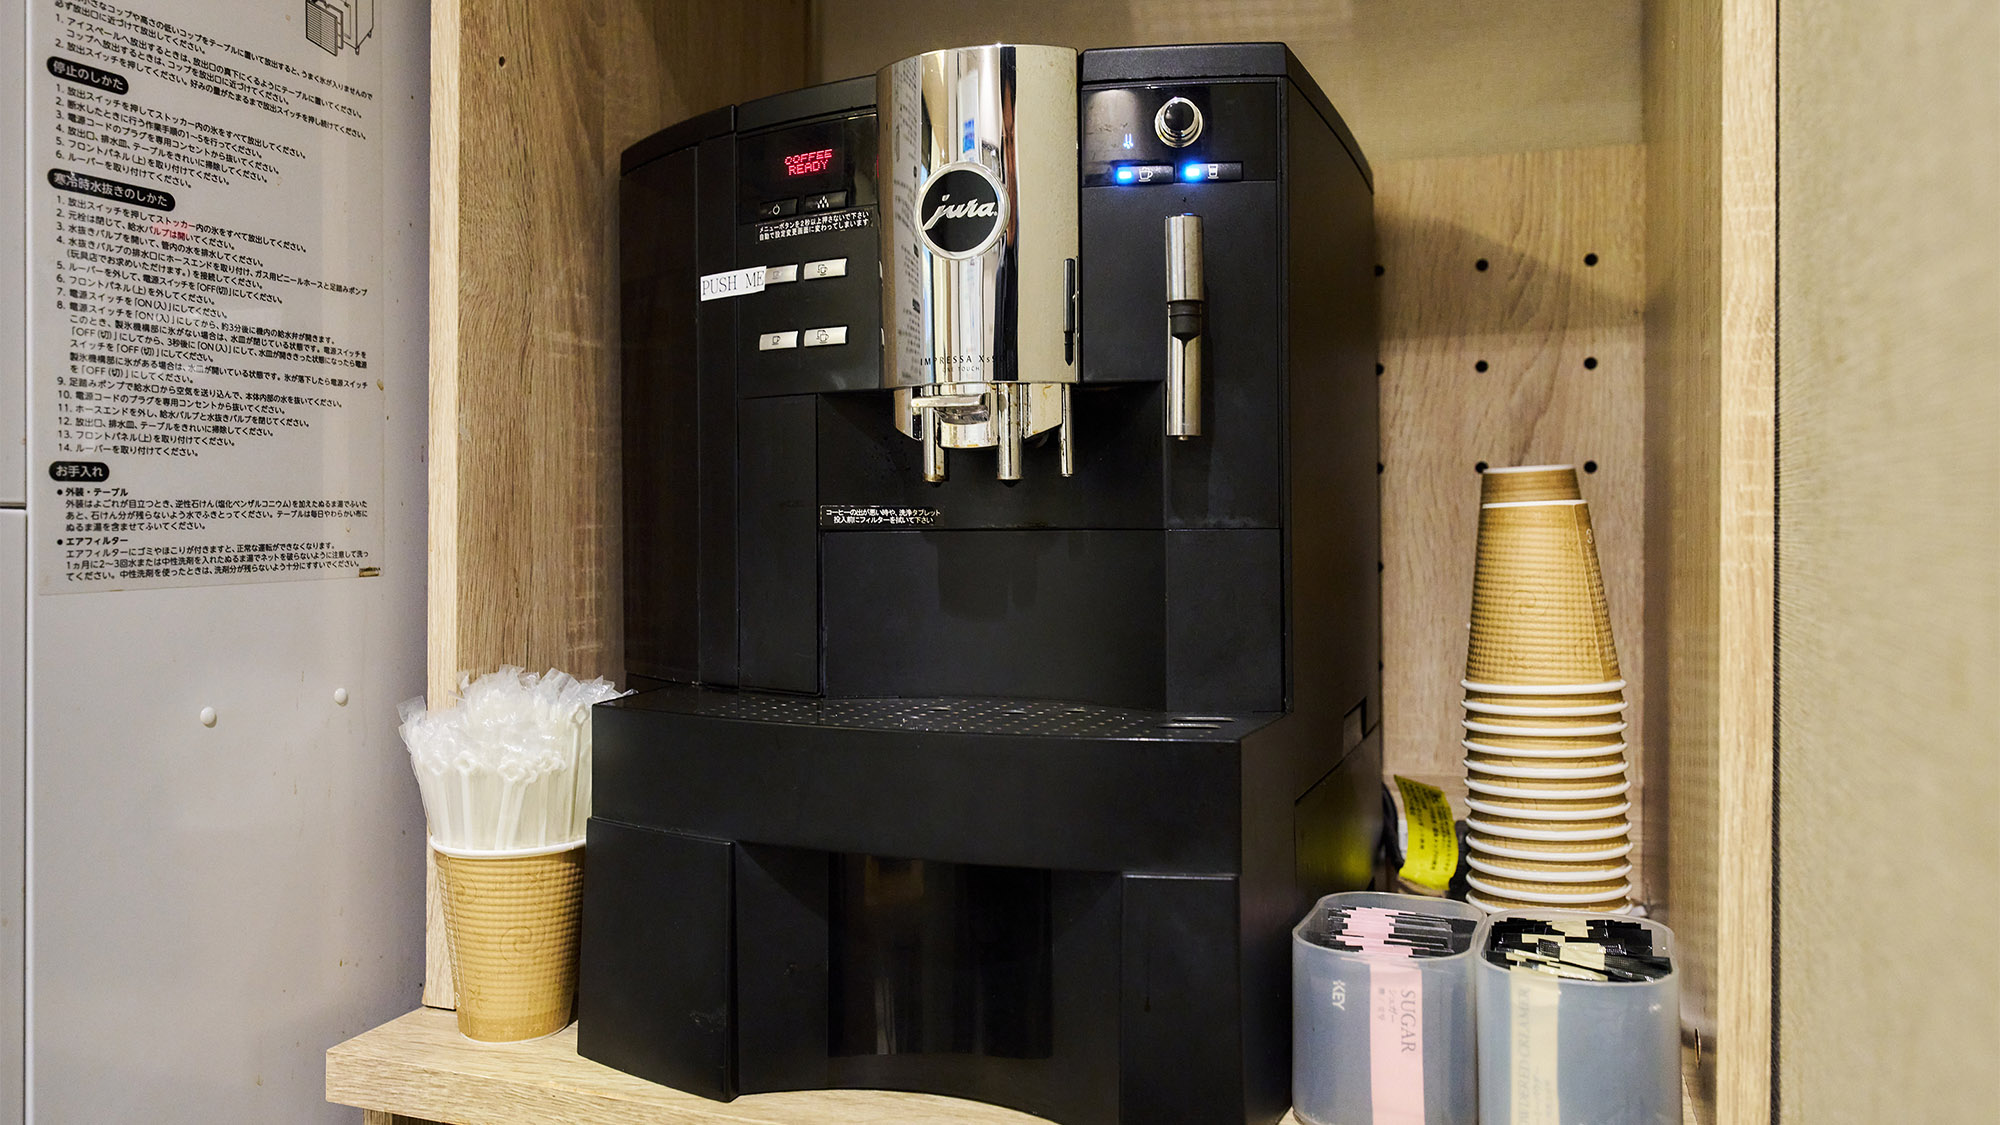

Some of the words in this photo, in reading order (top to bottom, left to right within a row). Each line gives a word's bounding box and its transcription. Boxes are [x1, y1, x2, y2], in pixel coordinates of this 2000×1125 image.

[56, 13, 64, 24] 1.
[55, 38, 64, 49] 2.
[53, 60, 125, 91] 停止のしかた
[56, 84, 64, 93] 1.
[55, 97, 64, 107] 2.
[55, 123, 64, 133] 4.
[55, 136, 64, 146] 5.
[55, 109, 64, 119] 3.
[67, 113, 280, 174] 電源コードのプラグを専用コンセントから抜いてください。
[784, 148, 833, 165] COFFEE
[55, 149, 64, 159] 6.
[68, 152, 192, 188] ルーバーを取り付けてください。
[788, 159, 829, 176] READY
[53, 172, 168, 207] 寒冷時水抜きのしかた
[56, 195, 65, 204] 1.
[56, 208, 65, 218] 2.
[56, 222, 65, 231] 3.
[759, 218, 869, 241] 自動で設定変更画面に変わってしまいます
[56, 235, 65, 244] 4.
[56, 261, 65, 270] 5.
[56, 274, 65, 283] 6.
[702, 275, 737, 296] PUSH
[745, 270, 765, 289] ME
[57, 287, 66, 296] 7.
[56, 300, 66, 310] 8.
[57, 376, 66, 386] 9.
[58, 390, 72, 400] 10.
[75, 391, 285, 415] 電源コードのプラグを専用コンセントから抜いてください。
[58, 403, 72, 412] 11.
[58, 416, 72, 426] 12.
[58, 430, 72, 439] 13.
[58, 443, 72, 452] 14.
[76, 444, 198, 457] ルーバーを取り付けてください。
[55, 465, 103, 477] お手入れ
[65, 522, 206, 532] ぬるま湯を含ませてふいてください。
[65, 537, 128, 546] エアフィルター
[1332, 980, 1346, 1011] KEY
[1400, 989, 1416, 1053] SUGAR
